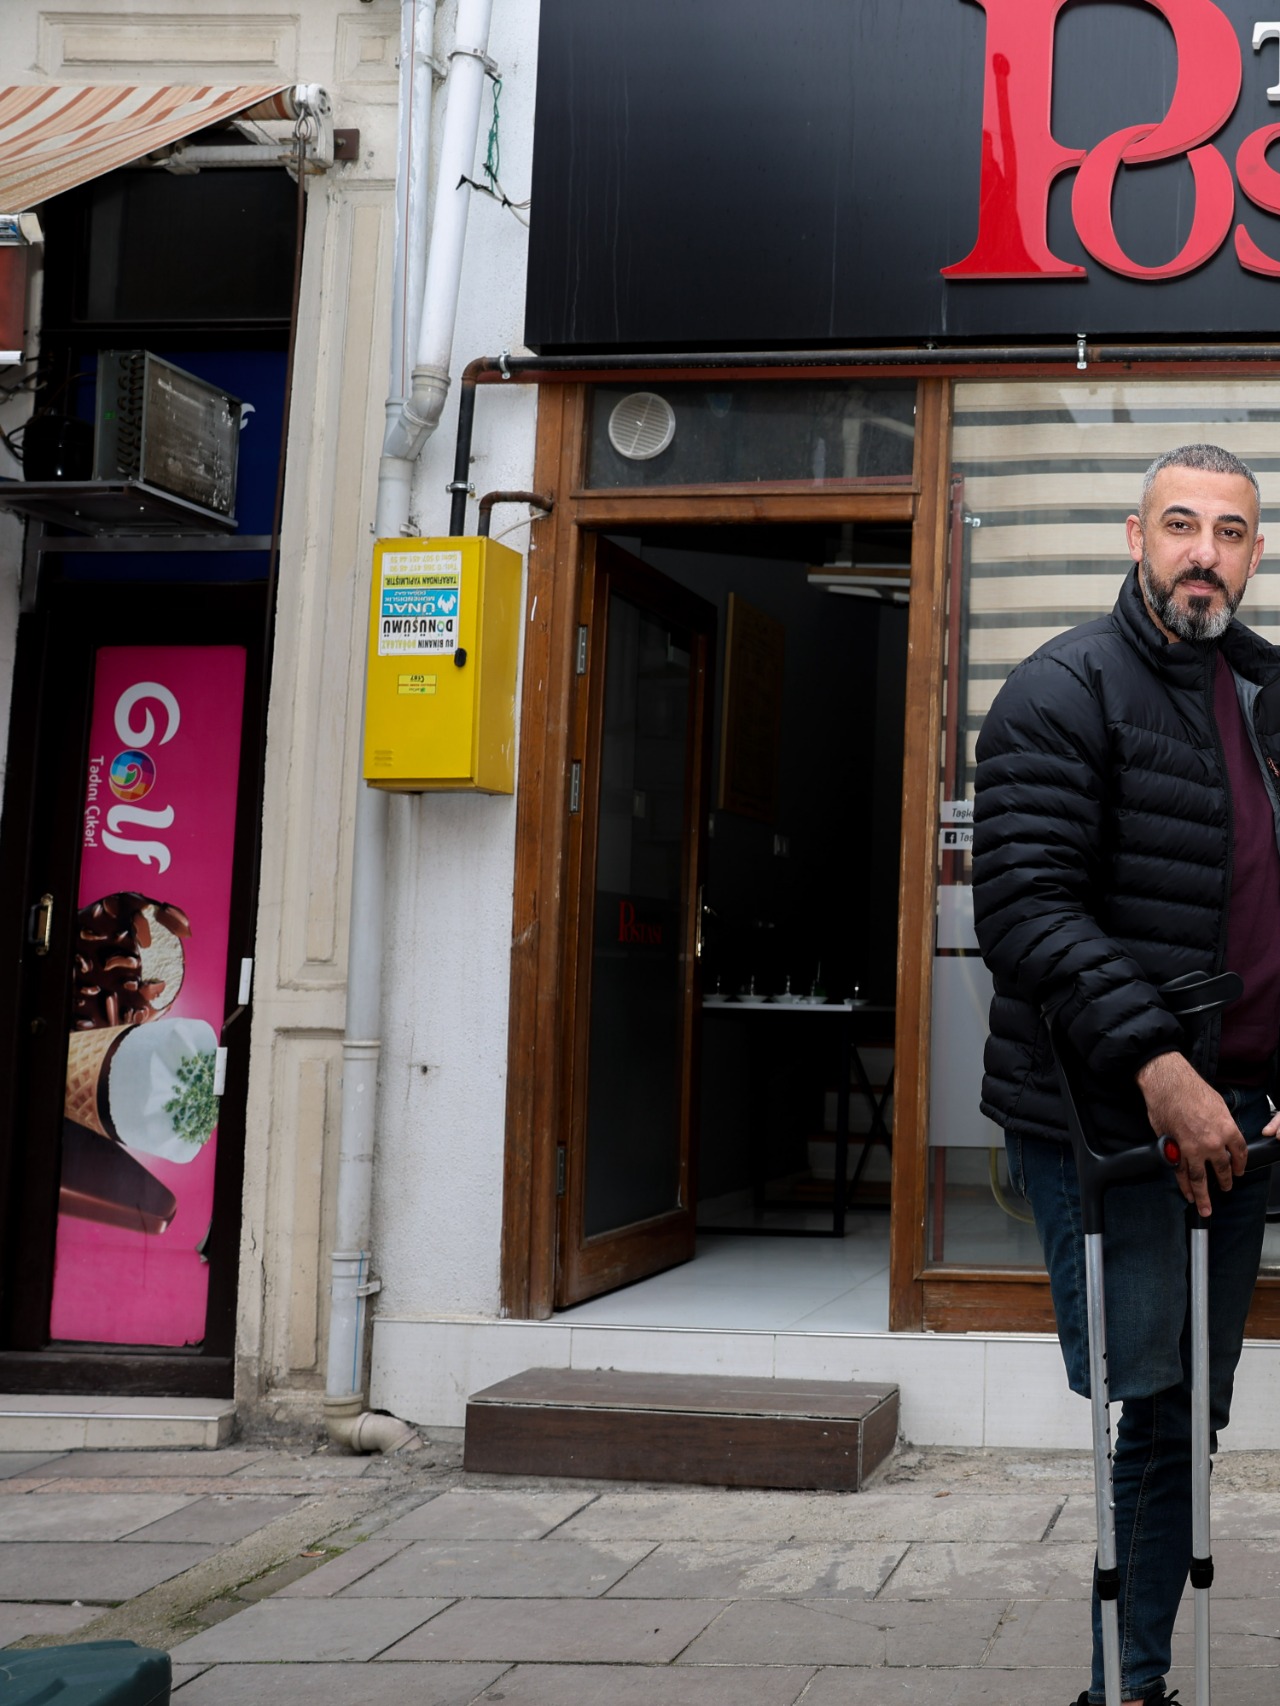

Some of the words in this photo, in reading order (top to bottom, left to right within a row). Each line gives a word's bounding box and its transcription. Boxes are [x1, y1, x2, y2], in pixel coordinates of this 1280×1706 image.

[422, 576, 457, 585] TARAFINDAN
[383, 602, 435, 615] ÜNAL
[383, 617, 453, 637] DÖNÜŞÜMÜ
[417, 639, 444, 650] BİNANIN
[445, 639, 454, 648] BU
[102, 681, 181, 875] Golf
